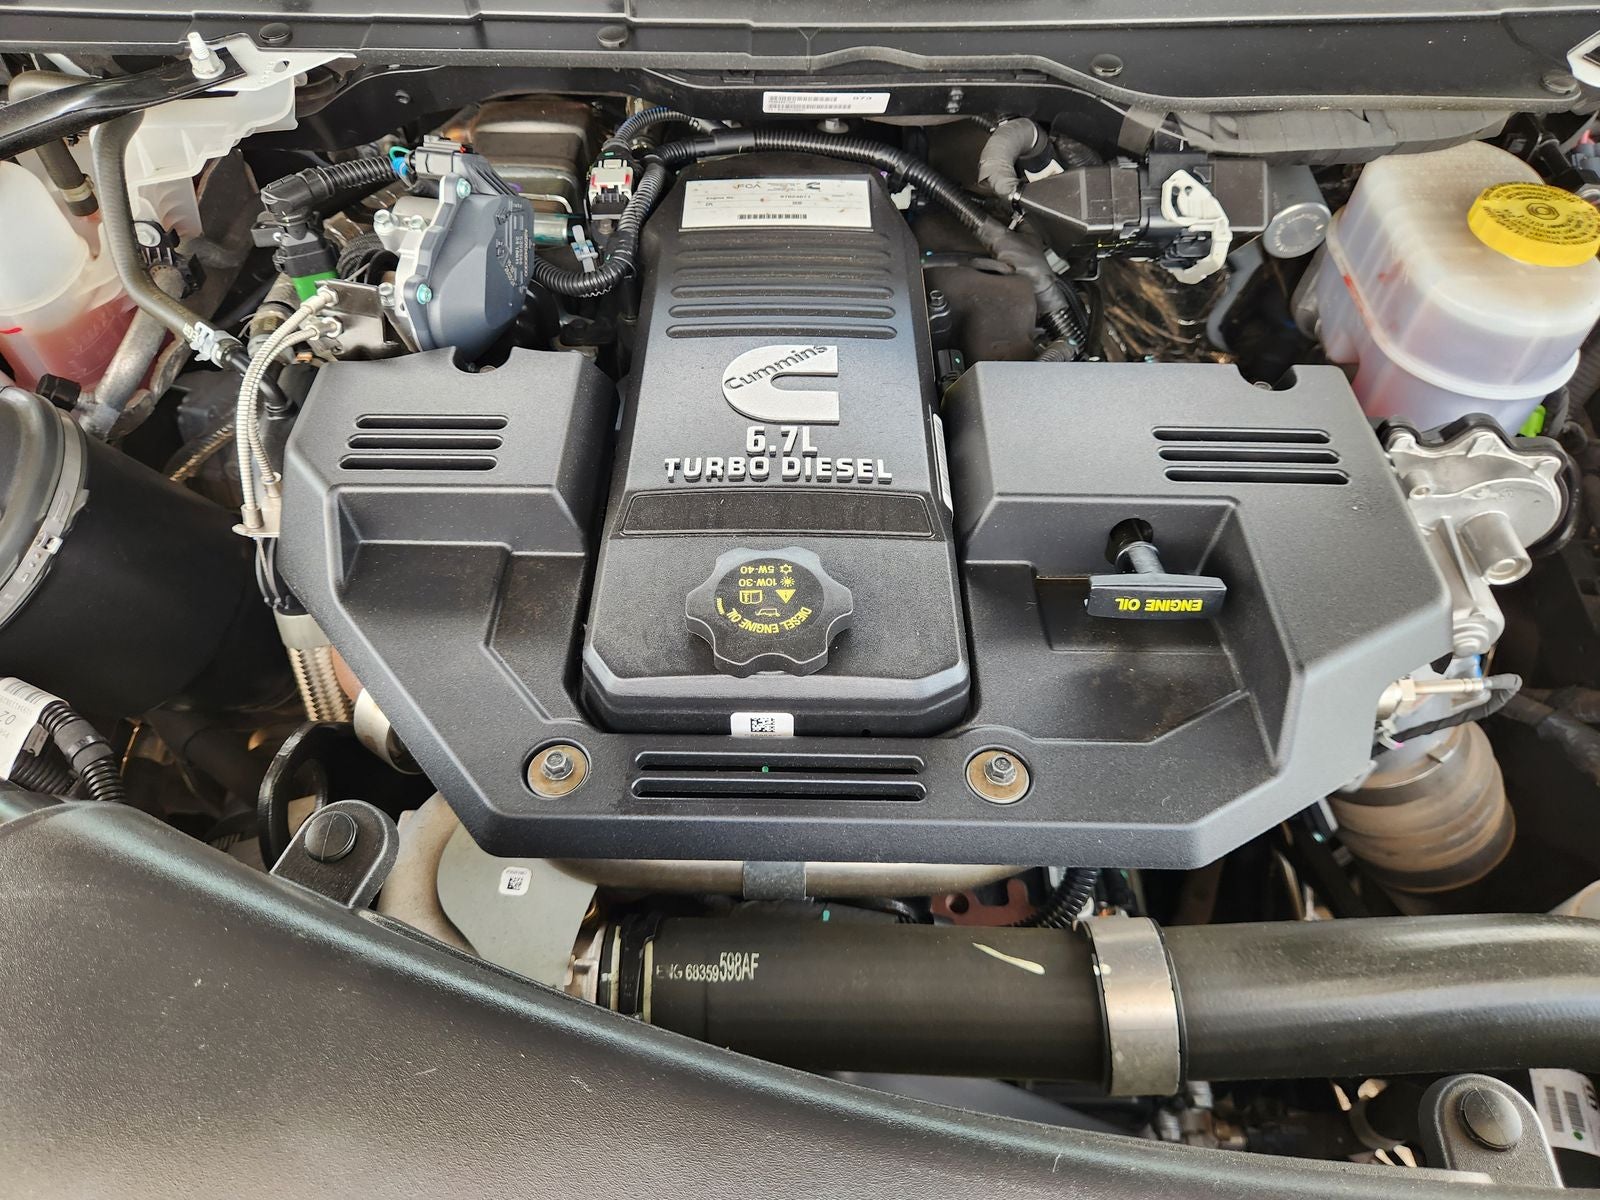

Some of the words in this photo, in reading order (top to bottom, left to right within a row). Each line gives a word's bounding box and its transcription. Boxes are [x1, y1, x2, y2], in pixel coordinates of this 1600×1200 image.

[723, 346, 828, 390] Cummins
[746, 426, 818, 457] 6.7L
[664, 457, 770, 483] TURBO
[782, 457, 893, 484] DIESEL
[740, 565, 775, 574] 5W-40
[738, 578, 777, 587] 10W-30
[1115, 598, 1141, 611] OIL
[1144, 599, 1204, 612] ENGINE
[726, 608, 742, 623] OIL
[779, 606, 812, 631] DIESEL
[738, 618, 780, 633] ENGINE
